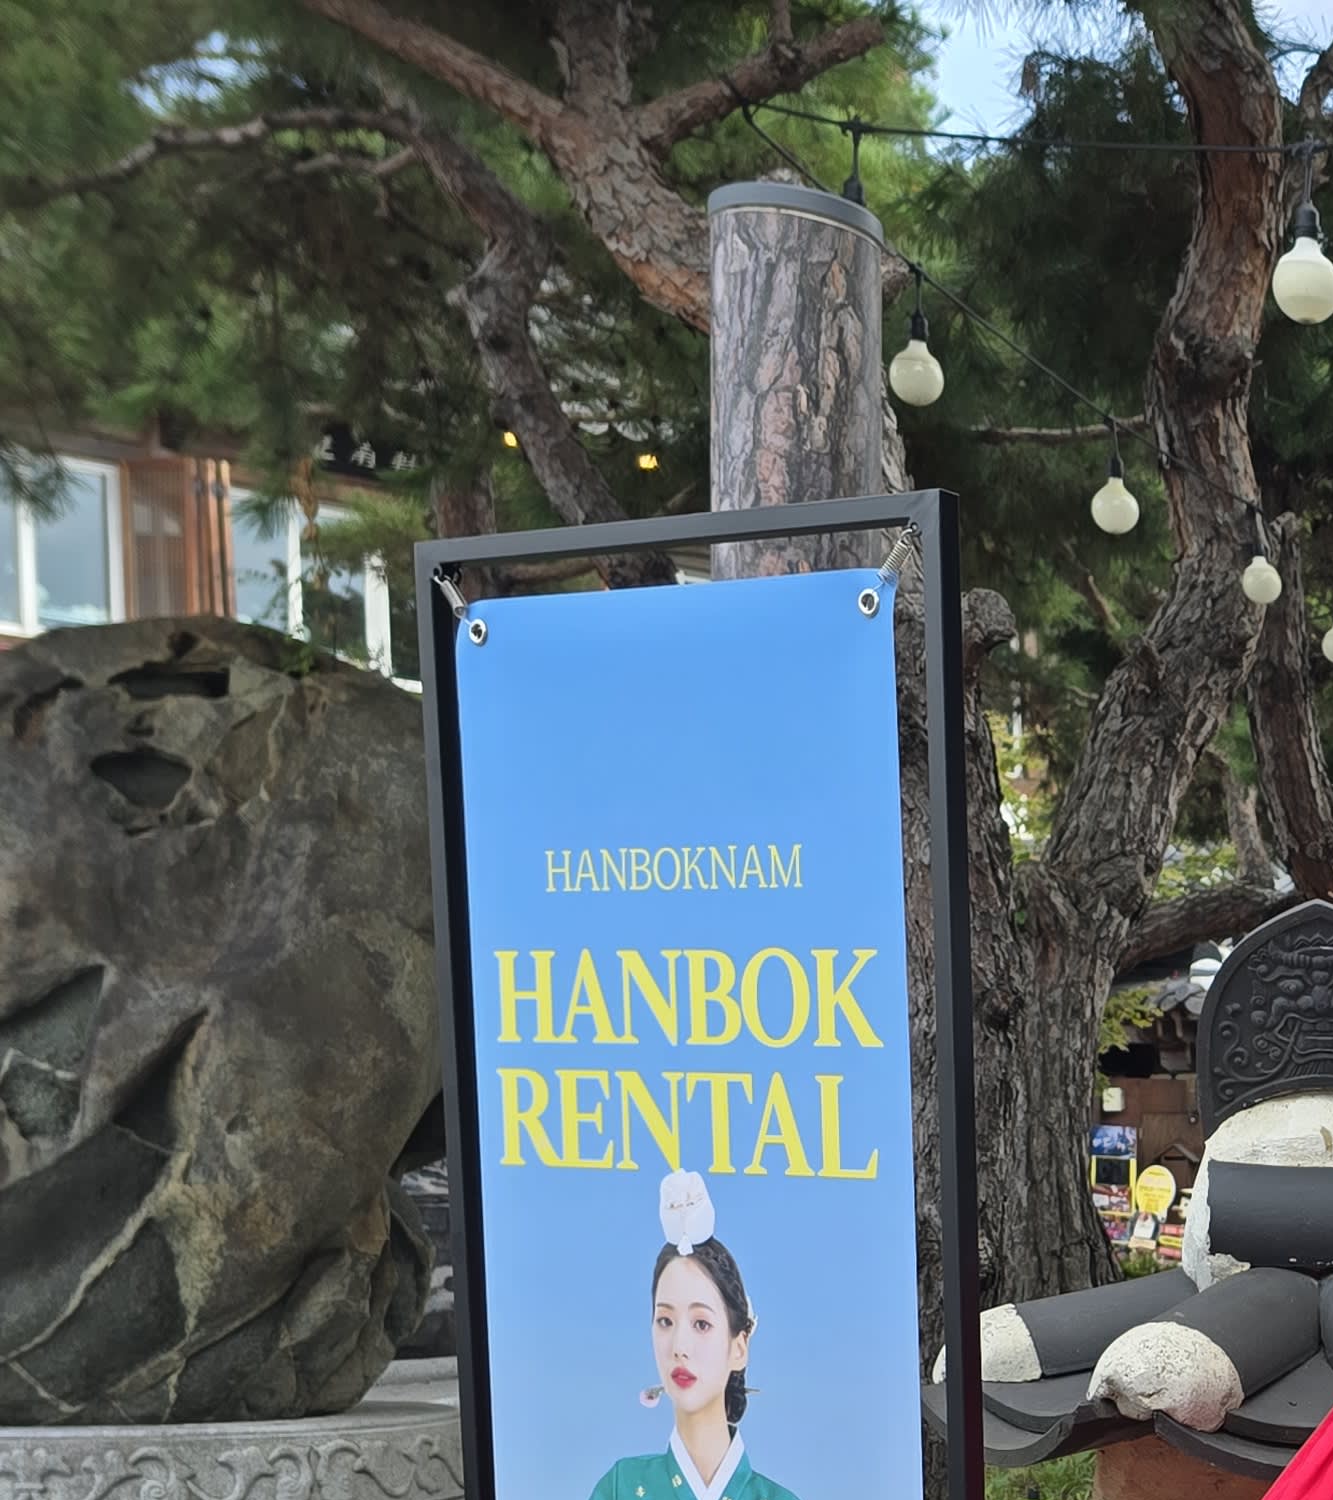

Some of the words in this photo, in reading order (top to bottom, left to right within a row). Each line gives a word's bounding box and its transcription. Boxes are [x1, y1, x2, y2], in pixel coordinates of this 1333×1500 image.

[544, 842, 804, 894] HANBOKNAM
[494, 946, 884, 1049] HANBOK
[498, 1066, 880, 1181] RENTAL
